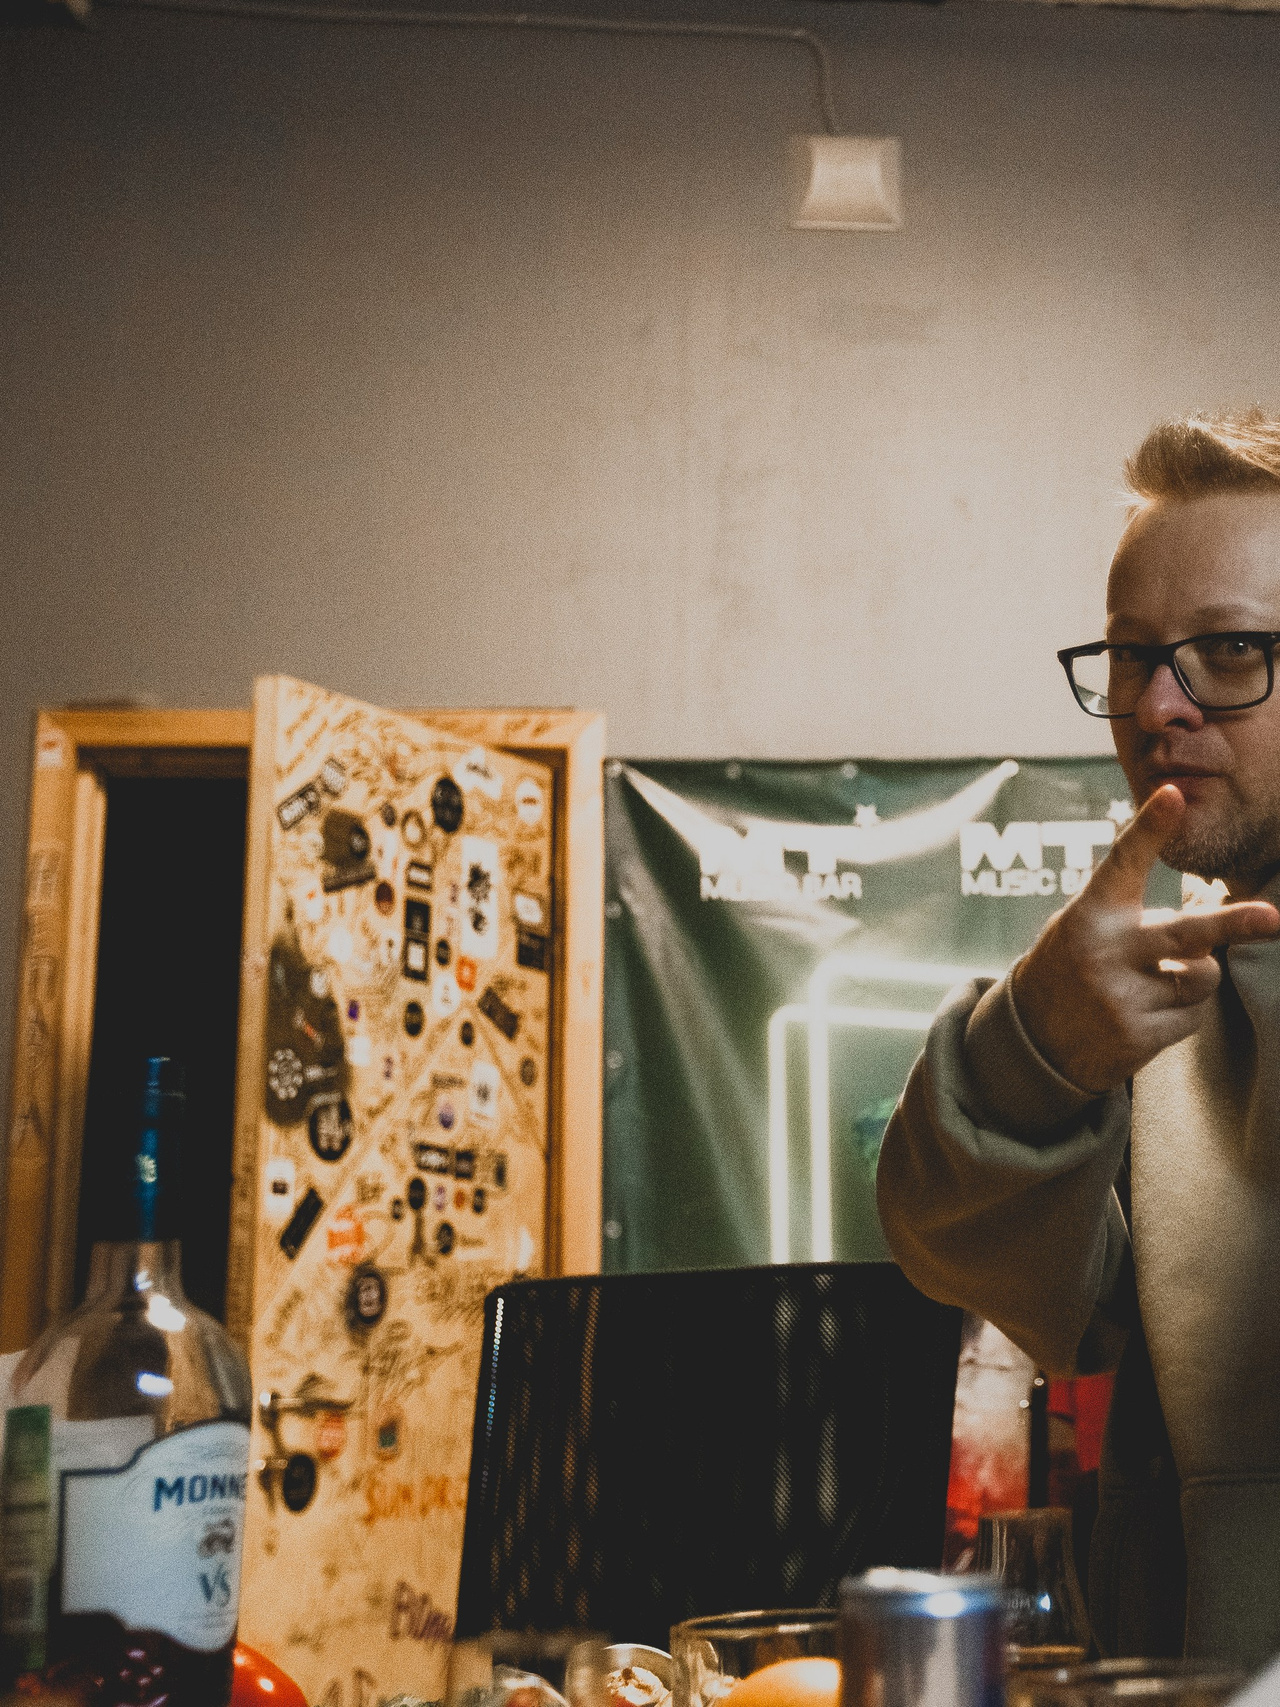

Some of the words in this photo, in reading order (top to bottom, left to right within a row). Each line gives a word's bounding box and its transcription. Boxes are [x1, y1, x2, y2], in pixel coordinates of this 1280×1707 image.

[960, 821, 1115, 869] MT
[803, 871, 862, 900] BAR
[961, 867, 1056, 896] MUSIC
